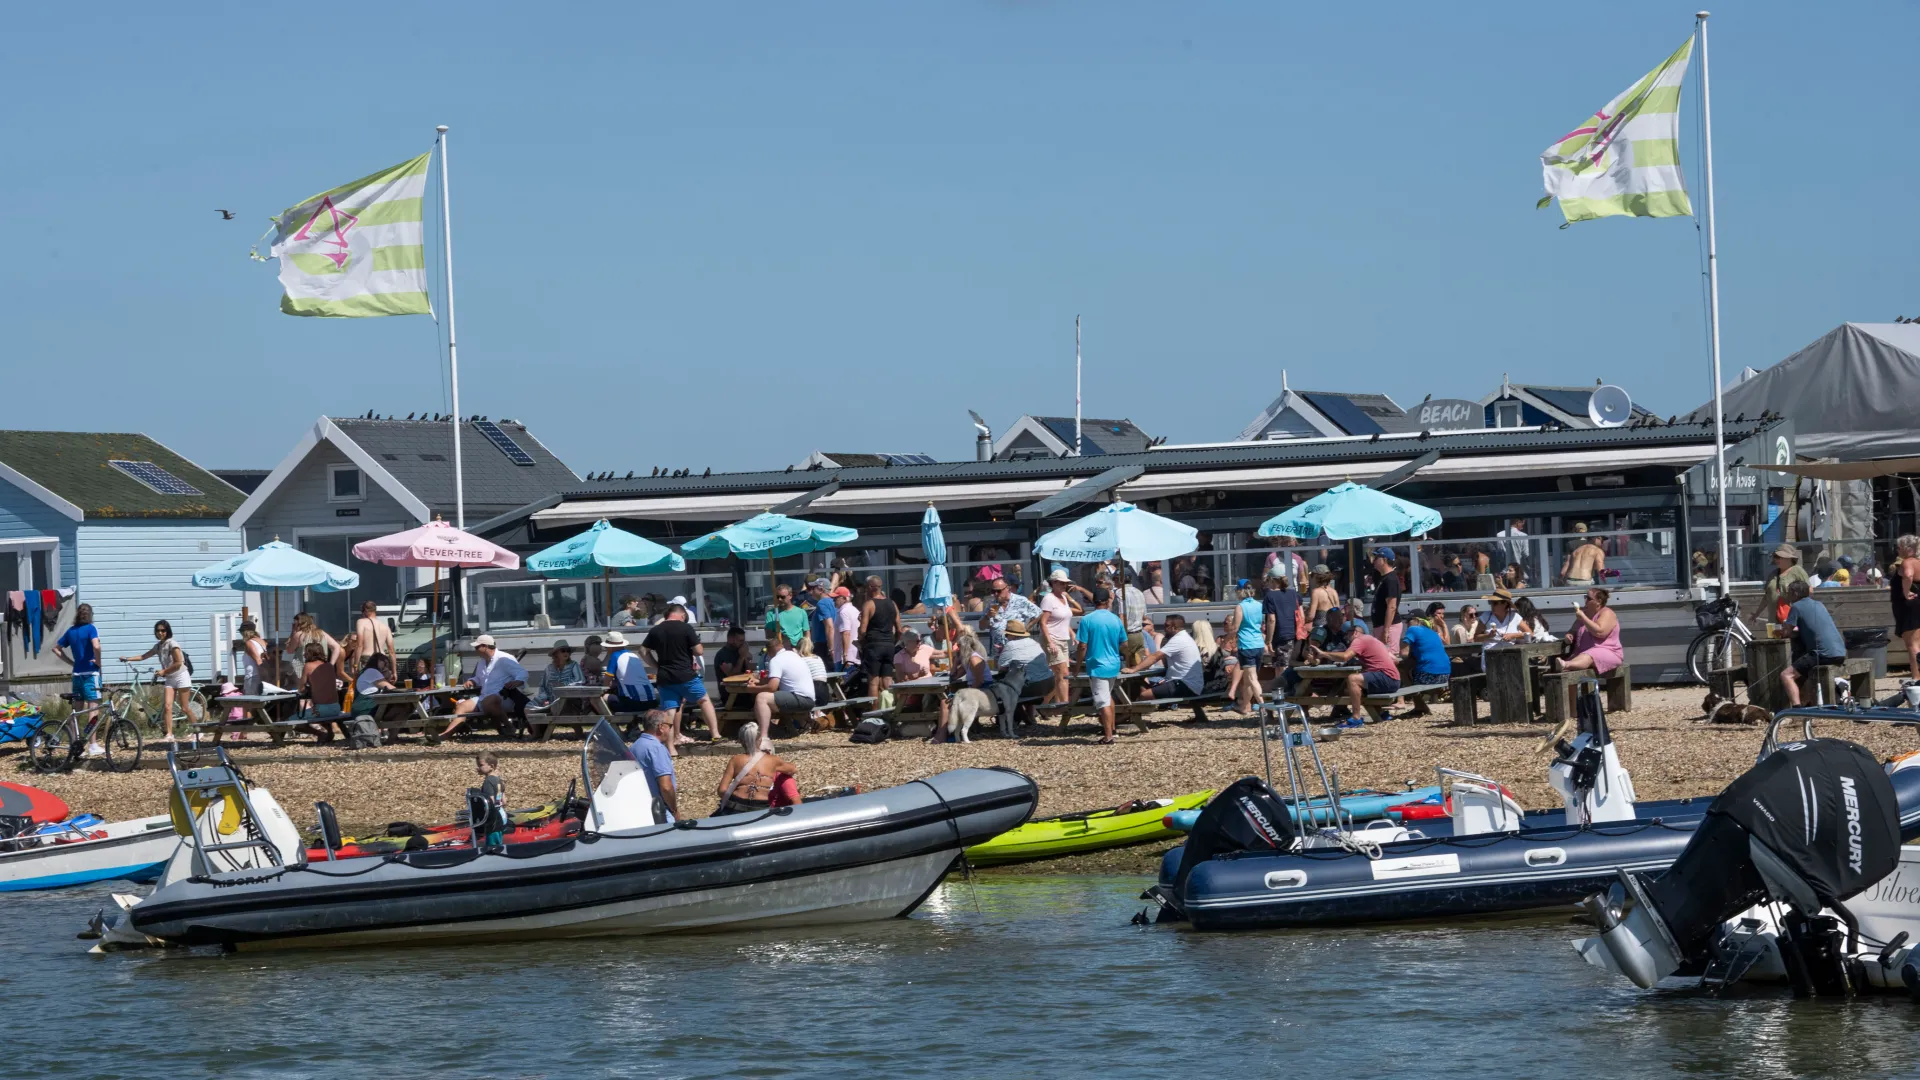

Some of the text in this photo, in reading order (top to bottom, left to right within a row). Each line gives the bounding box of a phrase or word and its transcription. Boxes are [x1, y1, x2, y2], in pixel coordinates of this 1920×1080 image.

[1420, 404, 1471, 424] BEACH
[1711, 465, 1757, 489] bch house
[423, 547, 483, 559] FEVER-TREE
[537, 558, 586, 568] FEVER-TR
[1052, 547, 1107, 558] FEVER-TREE
[1240, 796, 1282, 841] MERCURY
[1753, 798, 1775, 822] VERADO
[1839, 775, 1862, 875] MERCURY
